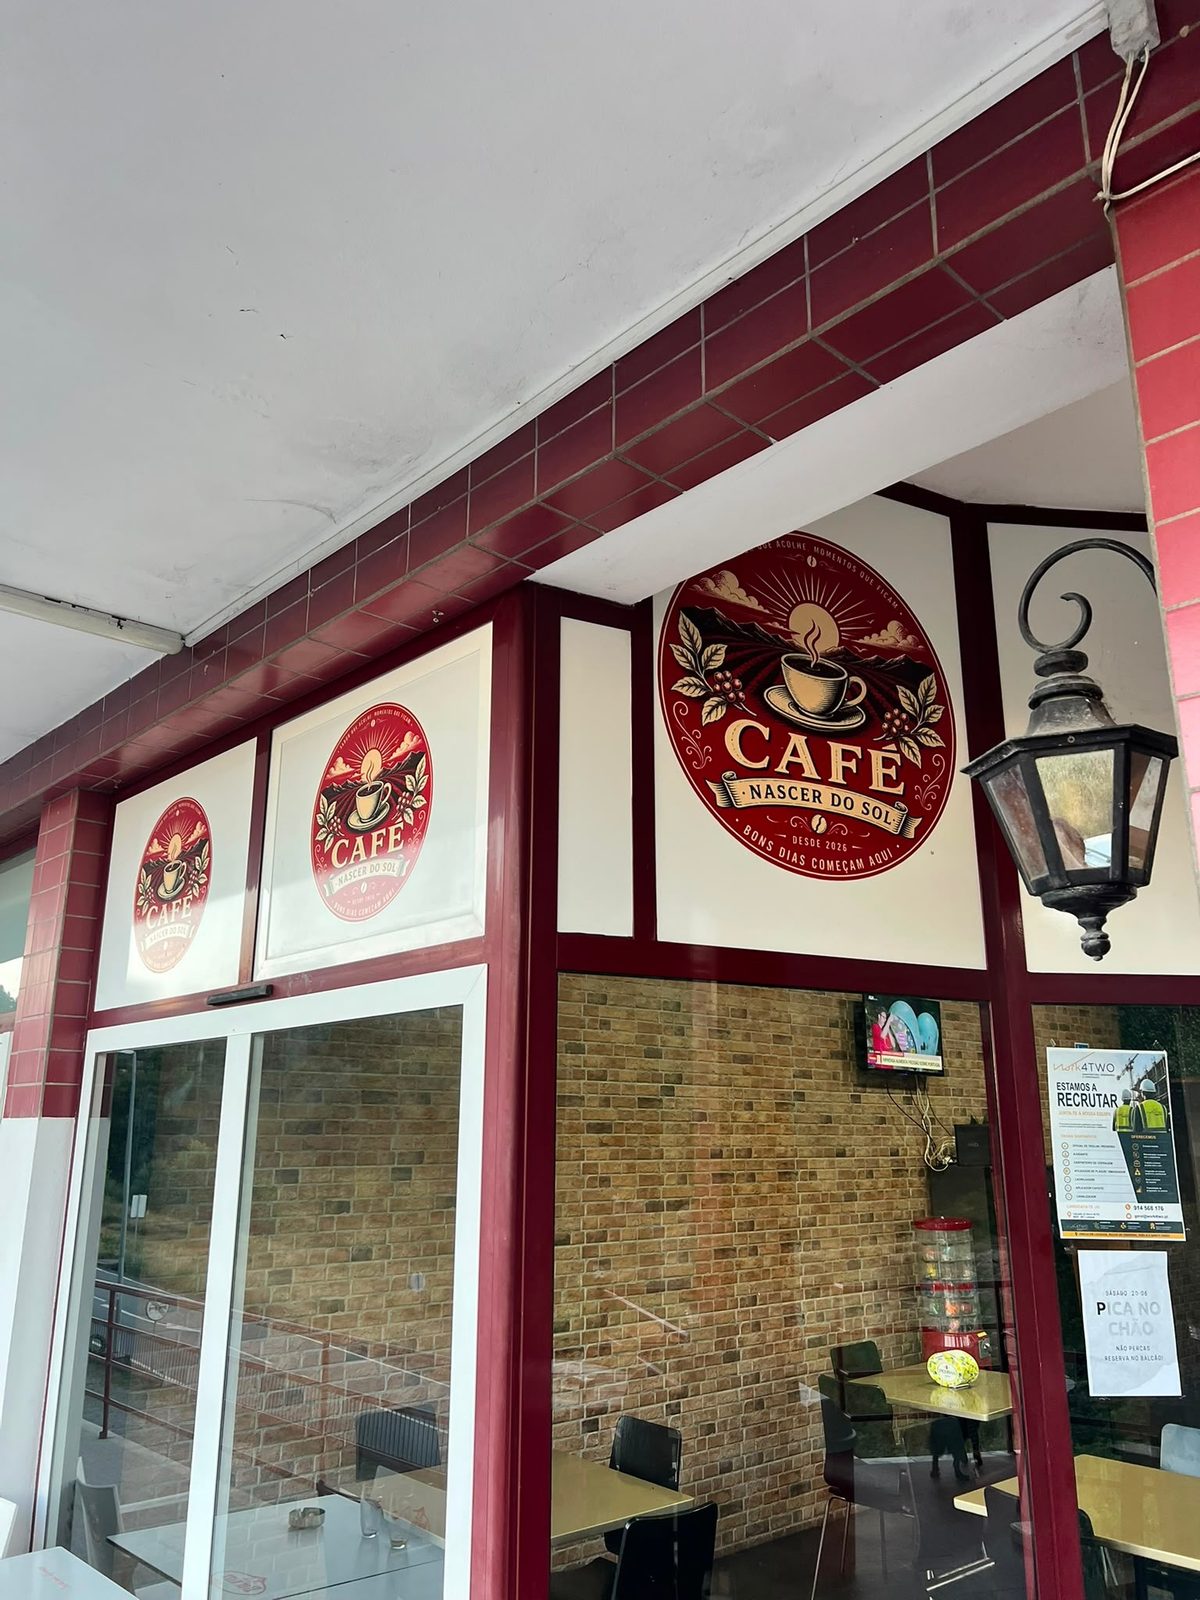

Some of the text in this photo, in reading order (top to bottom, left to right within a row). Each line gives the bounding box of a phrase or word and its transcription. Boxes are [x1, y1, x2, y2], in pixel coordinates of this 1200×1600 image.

[776, 540, 806, 551] ACOLHE
[813, 546, 857, 573] MOMENTOS
[859, 570, 874, 585] QUE
[876, 584, 898, 609] FICAM
[724, 718, 905, 795] CAFÉ
[748, 784, 892, 826] NASCER DO SOL
[330, 817, 405, 869] CAFÉ
[743, 824, 893, 874] BONS DIAS COMEÇAM AQUI
[792, 835, 848, 852] DESDE 2026
[338, 862, 396, 885] NASCER DO SOL
[145, 890, 193, 930] CAFÉ
[1056, 1082, 1097, 1092] ESTAMOS A
[1057, 1092, 1119, 1108] RECRUTAR
[1096, 1301, 1161, 1316] PICA NO
[1108, 1318, 1154, 1336] CHÃO
